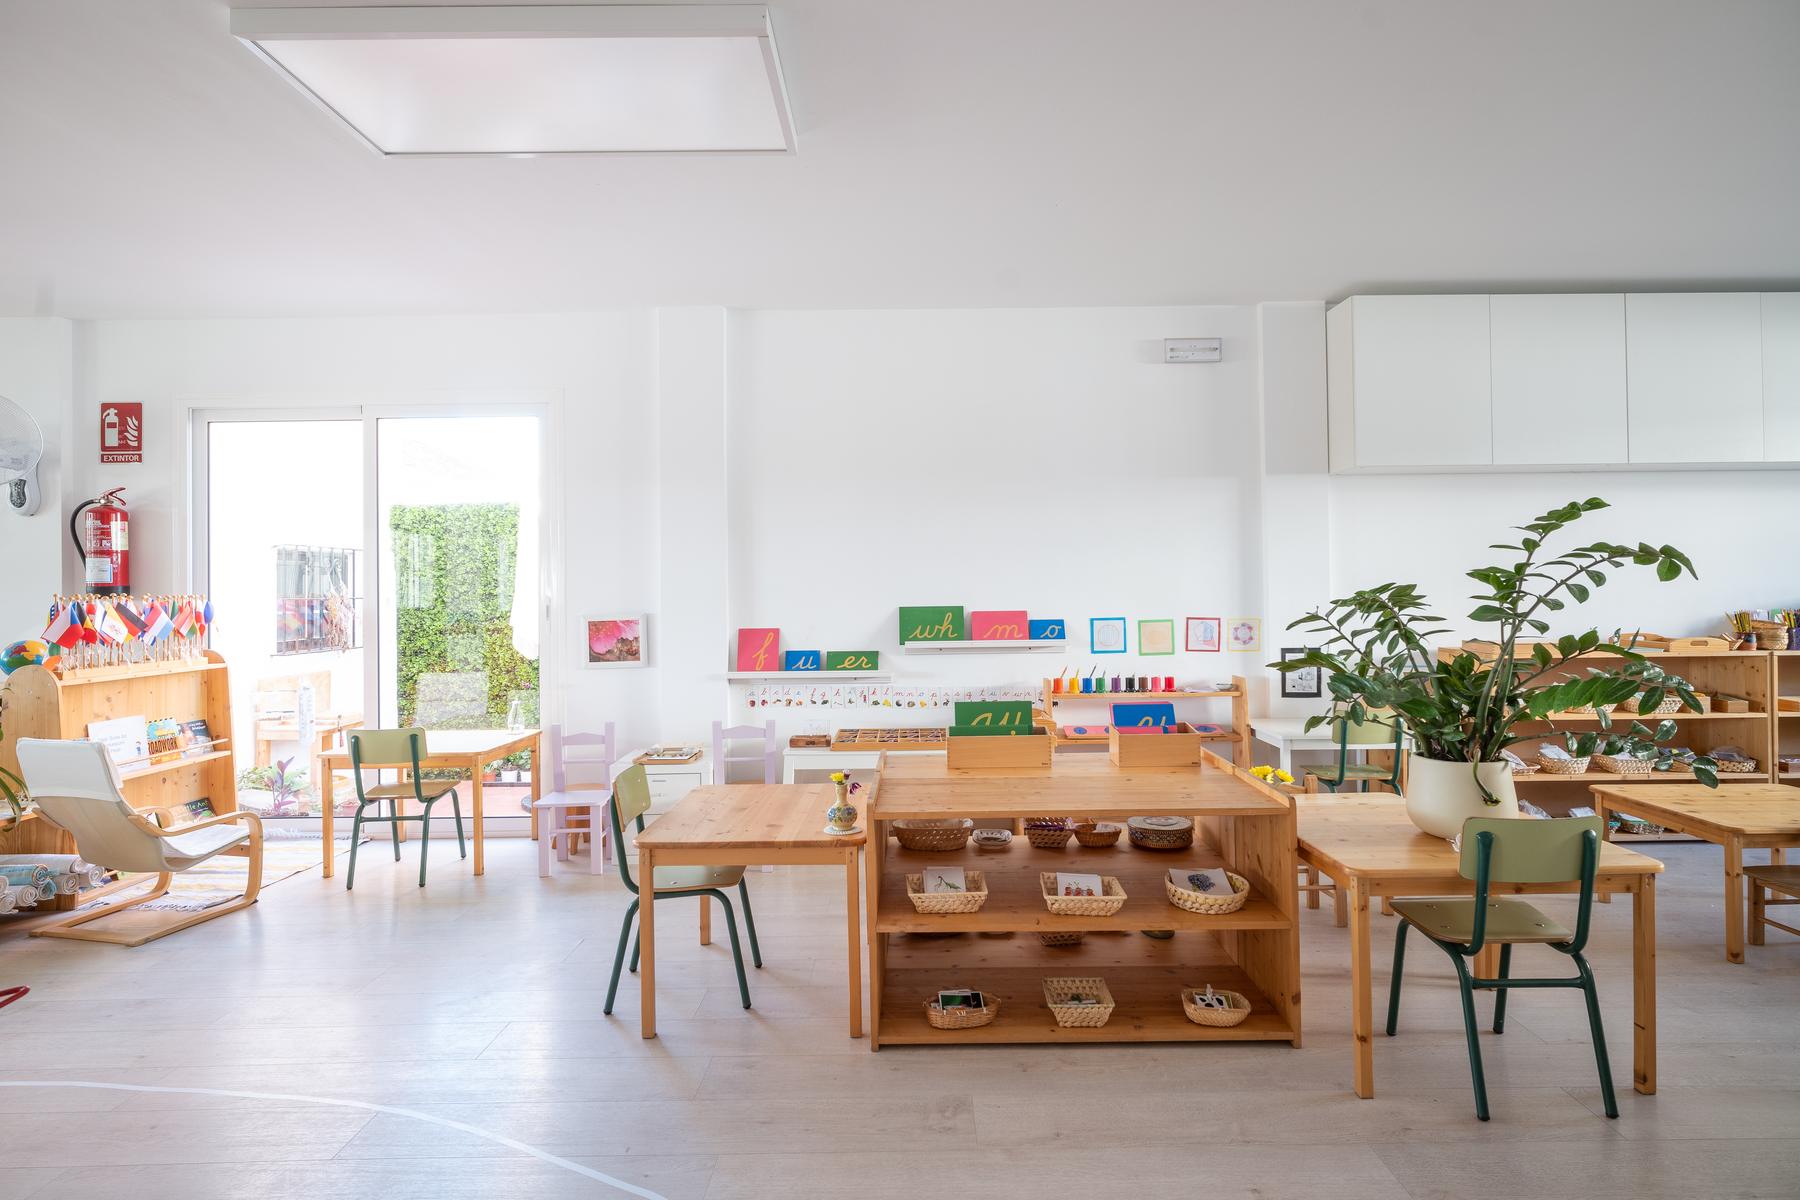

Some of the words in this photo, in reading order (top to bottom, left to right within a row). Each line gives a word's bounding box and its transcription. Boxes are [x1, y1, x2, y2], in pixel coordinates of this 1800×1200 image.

[103, 454, 139, 462] EXTINTOR
[908, 611, 958, 639] wh
[984, 624, 1023, 638] m
[1040, 624, 1062, 638] o
[752, 631, 774, 671] f
[791, 655, 816, 669] u
[836, 655, 872, 669] er
